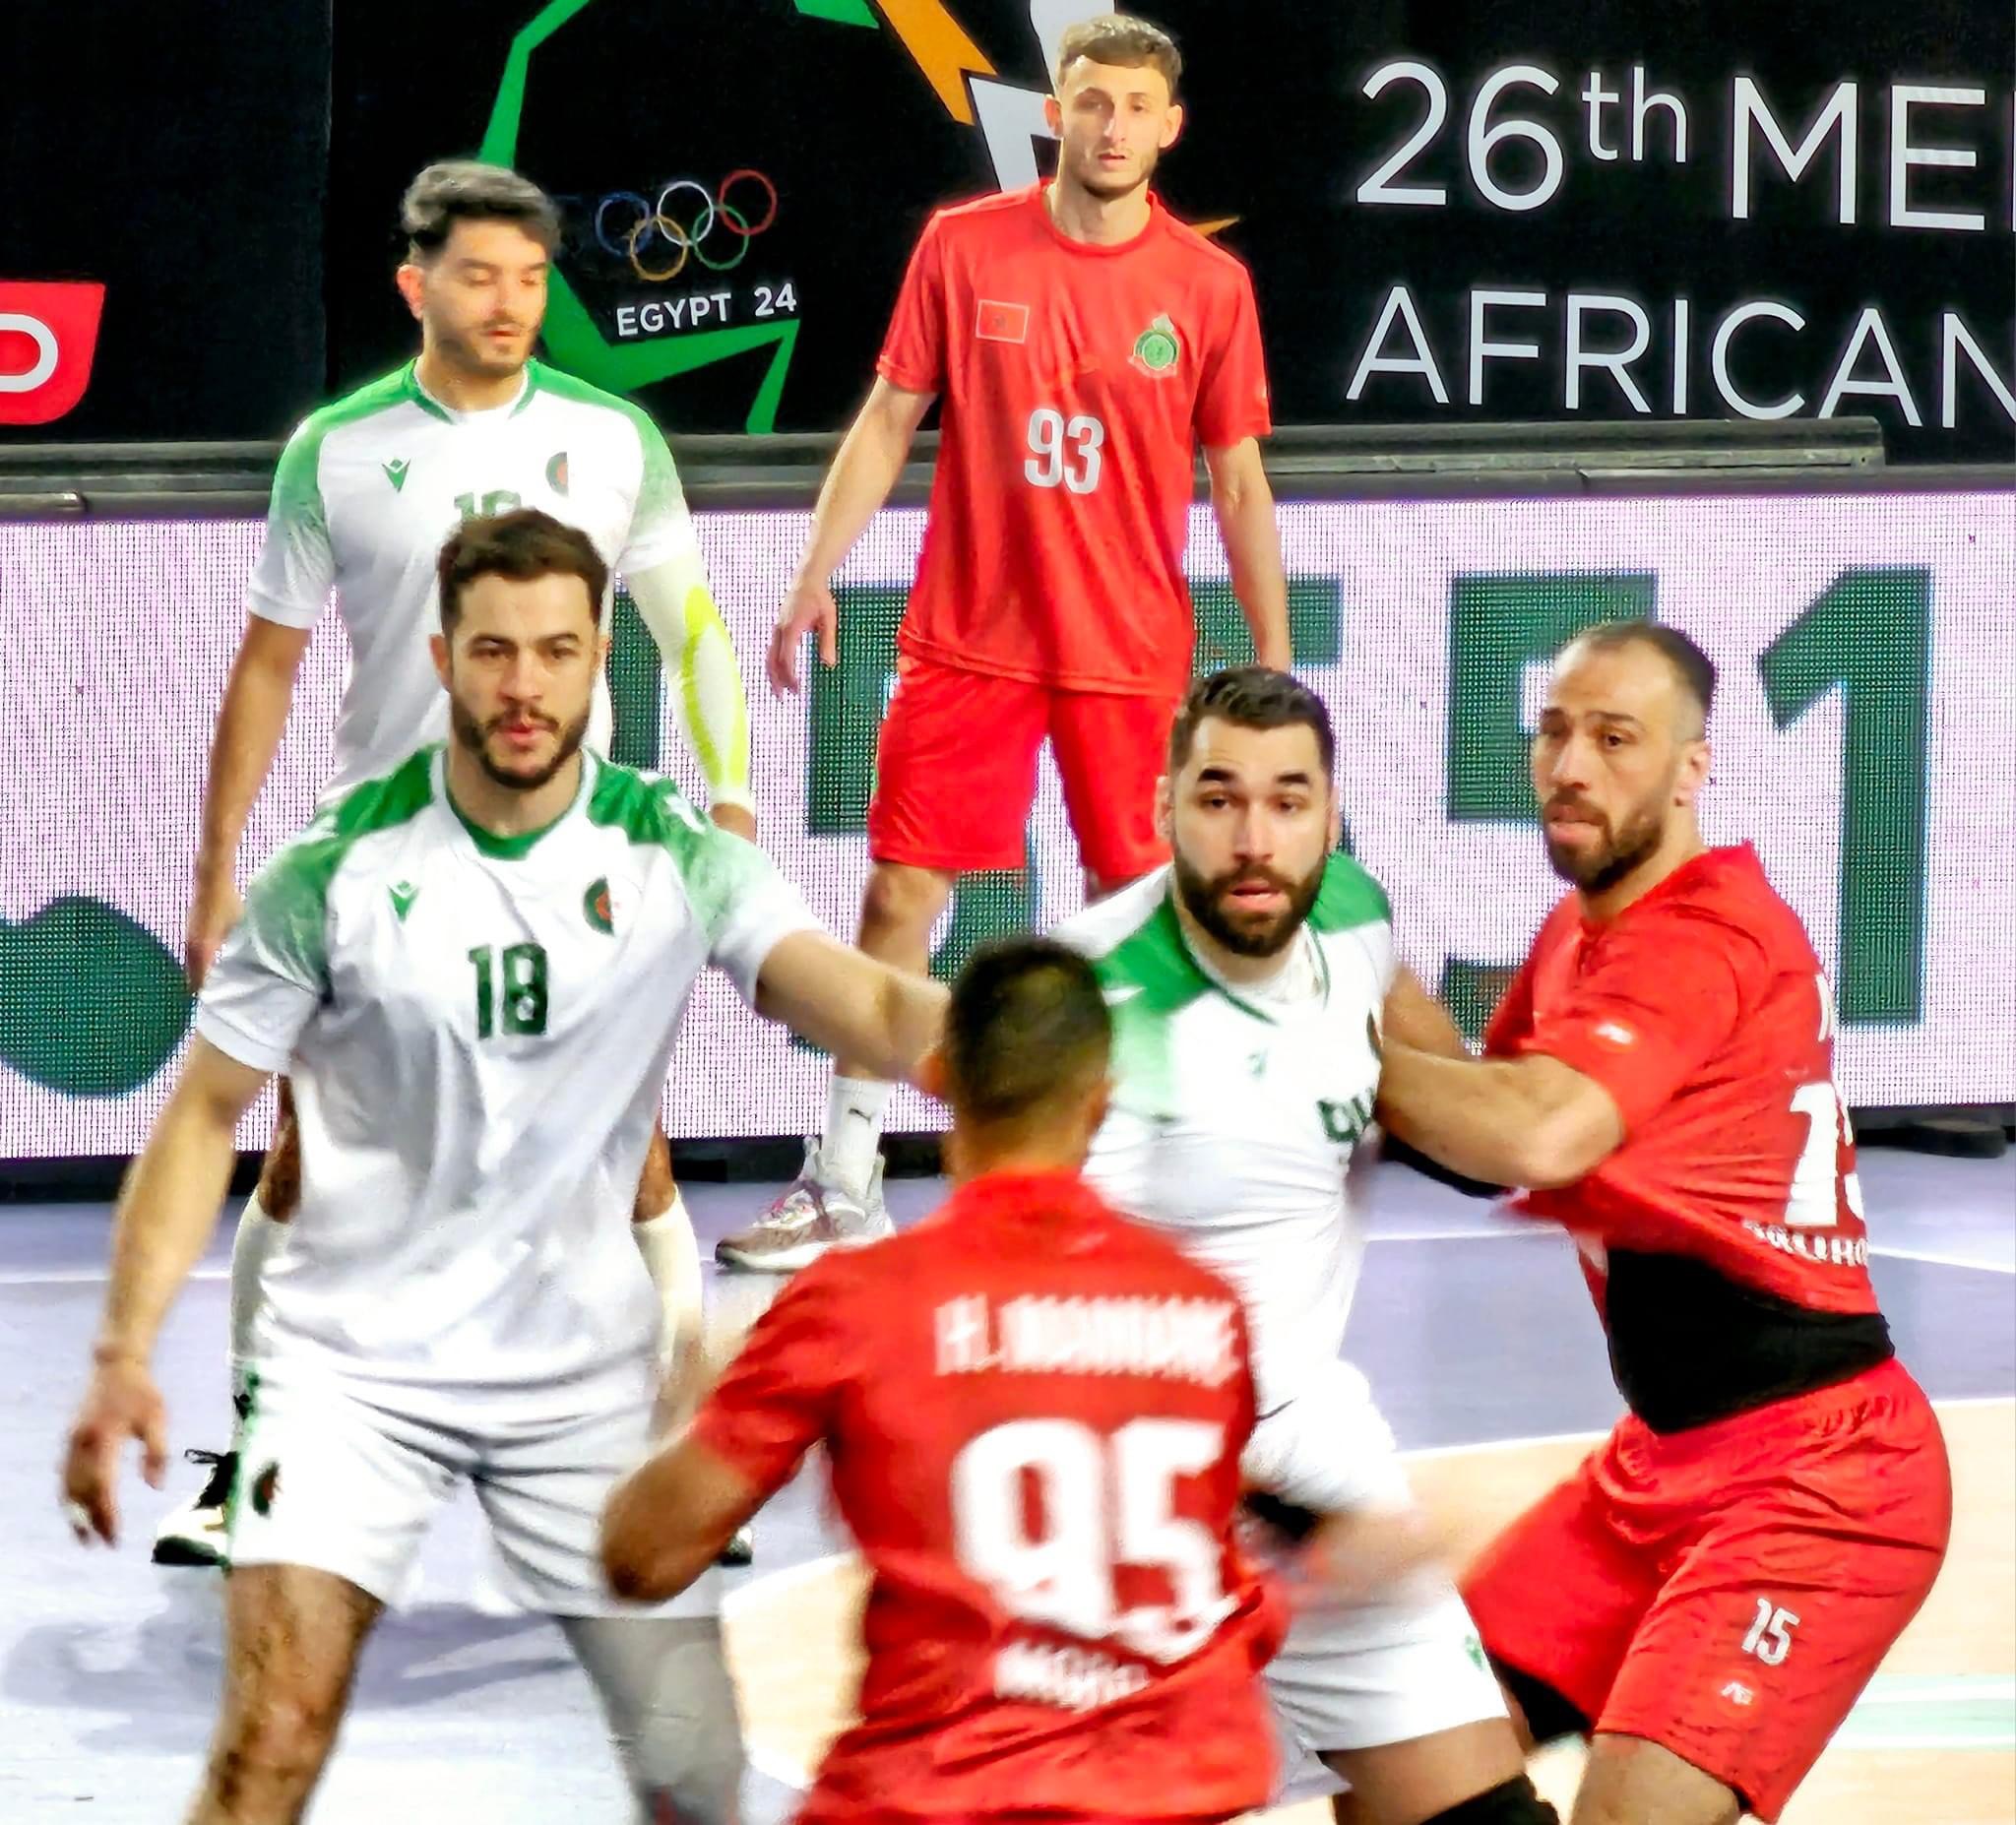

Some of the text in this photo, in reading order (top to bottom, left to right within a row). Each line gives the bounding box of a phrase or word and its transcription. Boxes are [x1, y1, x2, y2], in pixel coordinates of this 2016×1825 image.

[1356, 61, 2016, 232] 26th ME
[616, 283, 797, 337] EGYPT 24
[1025, 409, 1104, 494] 93
[468, 942, 548, 1040] 18
[949, 1416, 1240, 1666] 95
[1741, 1598, 1800, 1666] 15
